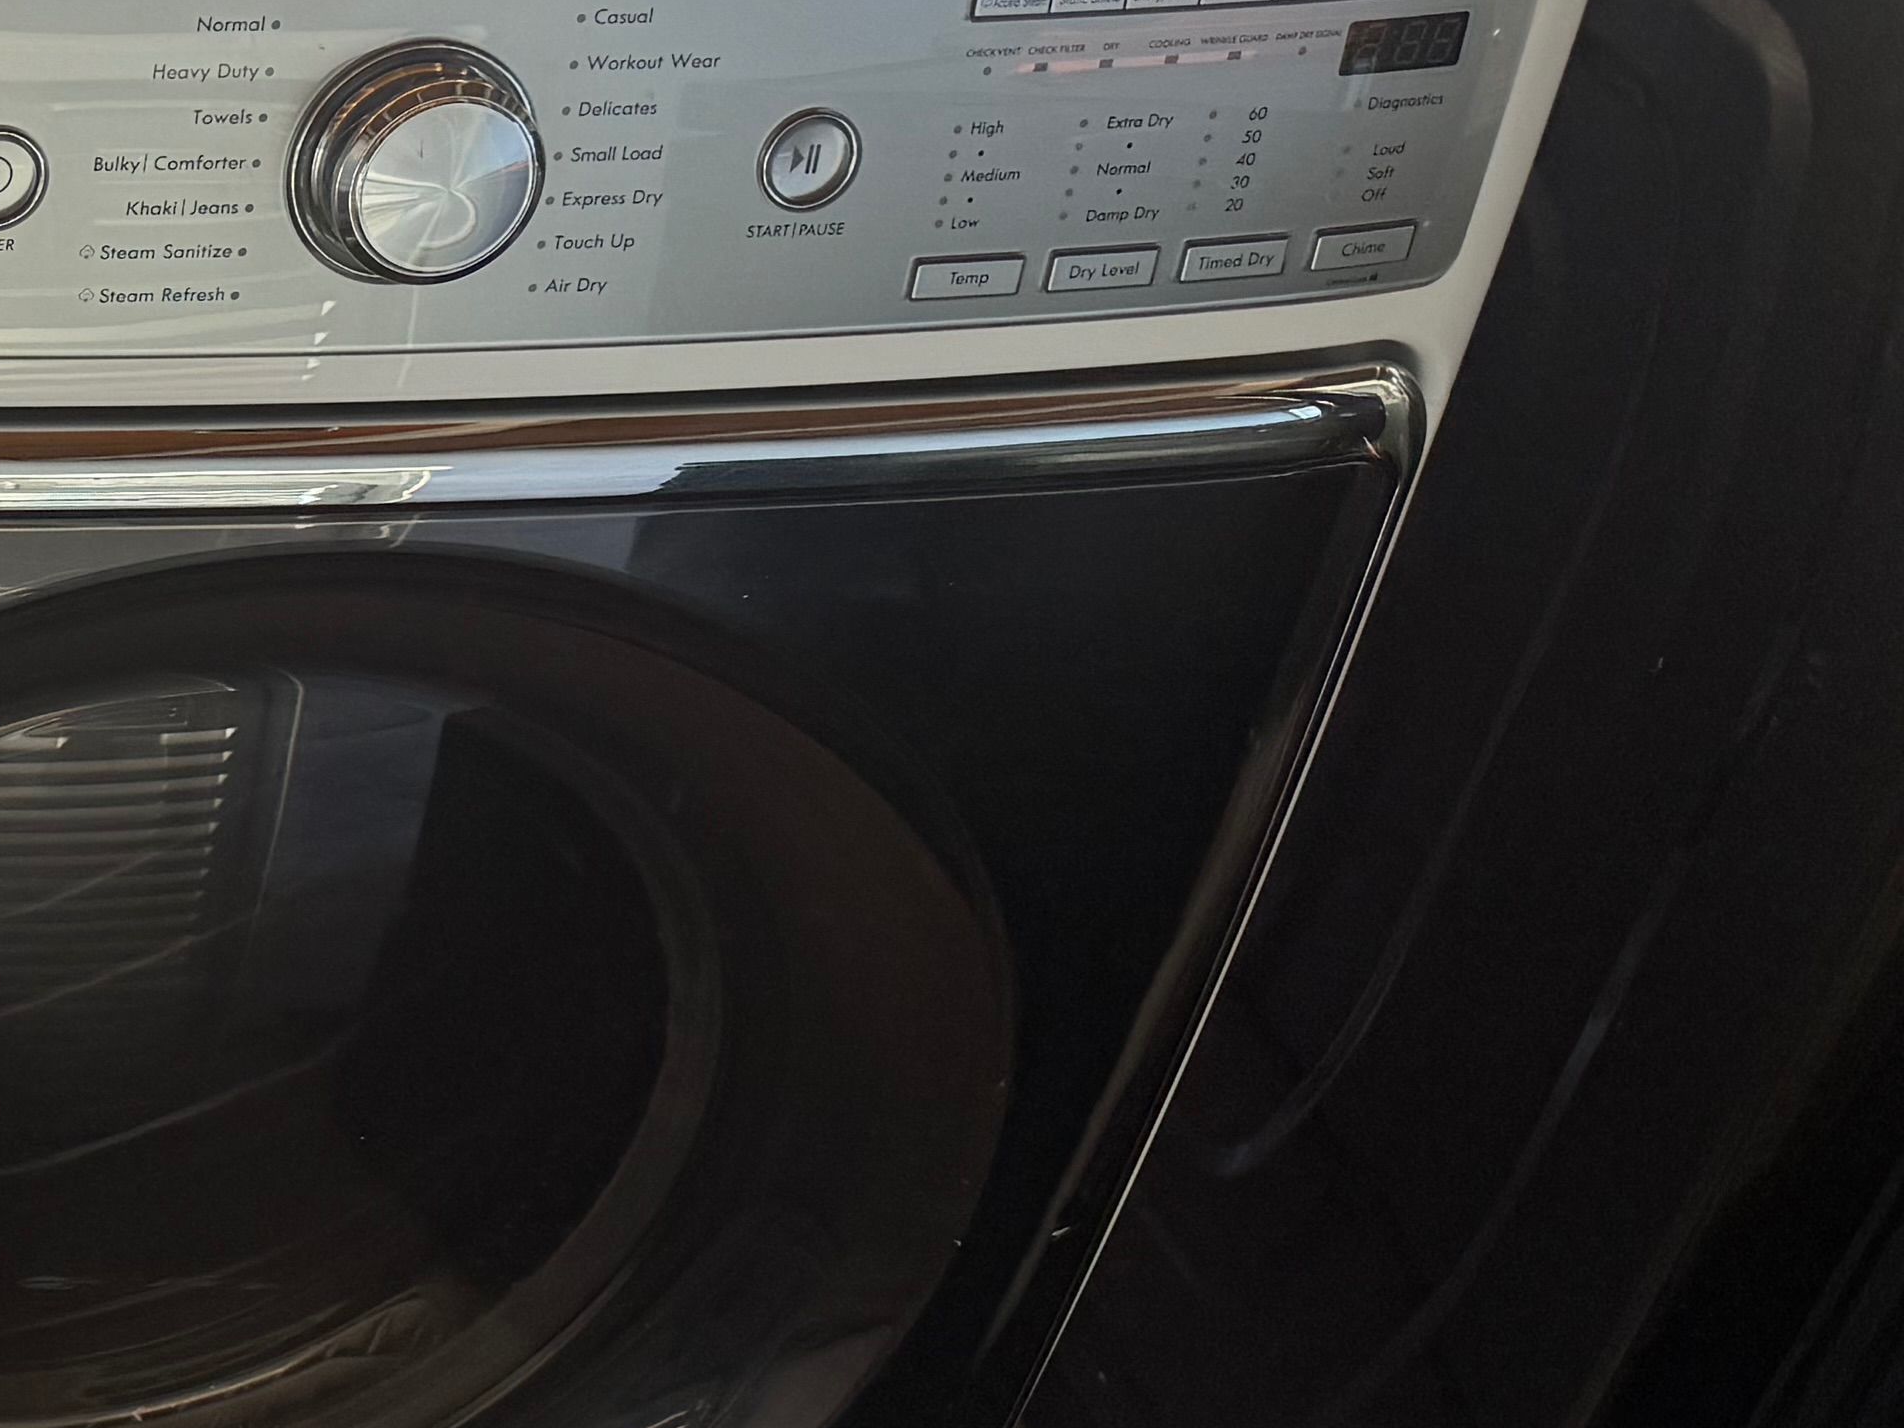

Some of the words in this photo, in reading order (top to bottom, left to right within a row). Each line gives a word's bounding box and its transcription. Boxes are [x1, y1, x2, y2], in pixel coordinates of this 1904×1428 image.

[196, 15, 266, 33] Normal
[594, 8, 654, 25] Casual
[1028, 45, 1058, 55] CHECK
[1149, 38, 1191, 49] COOLING
[587, 55, 664, 72] Workout
[671, 52, 721, 69] Wear
[152, 64, 211, 82] Heavy
[218, 63, 260, 81] Duty
[578, 100, 658, 118] Delicates
[1368, 94, 1443, 111] Diagnostics
[193, 109, 253, 125] Towels
[1107, 116, 1142, 129] Extra
[1148, 113, 1174, 128] Dry
[1249, 107, 1268, 121] 60
[971, 121, 1004, 137] High
[1242, 130, 1262, 143] 50
[570, 146, 618, 163] Small
[621, 144, 664, 161] Load
[1374, 141, 1406, 156] Loud
[154, 155, 246, 172] Comforter
[1236, 153, 1256, 166] 40
[961, 170, 1020, 182] Medium
[1096, 161, 1151, 175] Normal
[1367, 166, 1395, 180] Soft
[1231, 176, 1249, 189] 30
[561, 192, 626, 209] Express
[632, 190, 663, 208] Dry
[1361, 187, 1387, 201] Off
[1224, 199, 1243, 212] 20
[1086, 210, 1129, 223] Damp
[1134, 207, 1160, 221] Dry
[951, 218, 979, 229] Low
[100, 244, 156, 261] Steam
[163, 241, 233, 260] Sanitize
[554, 235, 604, 250] Touch
[610, 234, 635, 252] Up
[1342, 242, 1385, 257] Chime
[1199, 254, 1242, 269] Timed
[1248, 251, 1275, 267] Dry
[1069, 265, 1096, 280] Dry
[1101, 261, 1139, 276] Level
[544, 279, 569, 293] Air
[577, 277, 608, 294] Dry
[950, 272, 989, 287] Temp
[99, 288, 154, 304] Steam
[161, 285, 225, 302] Refresh
